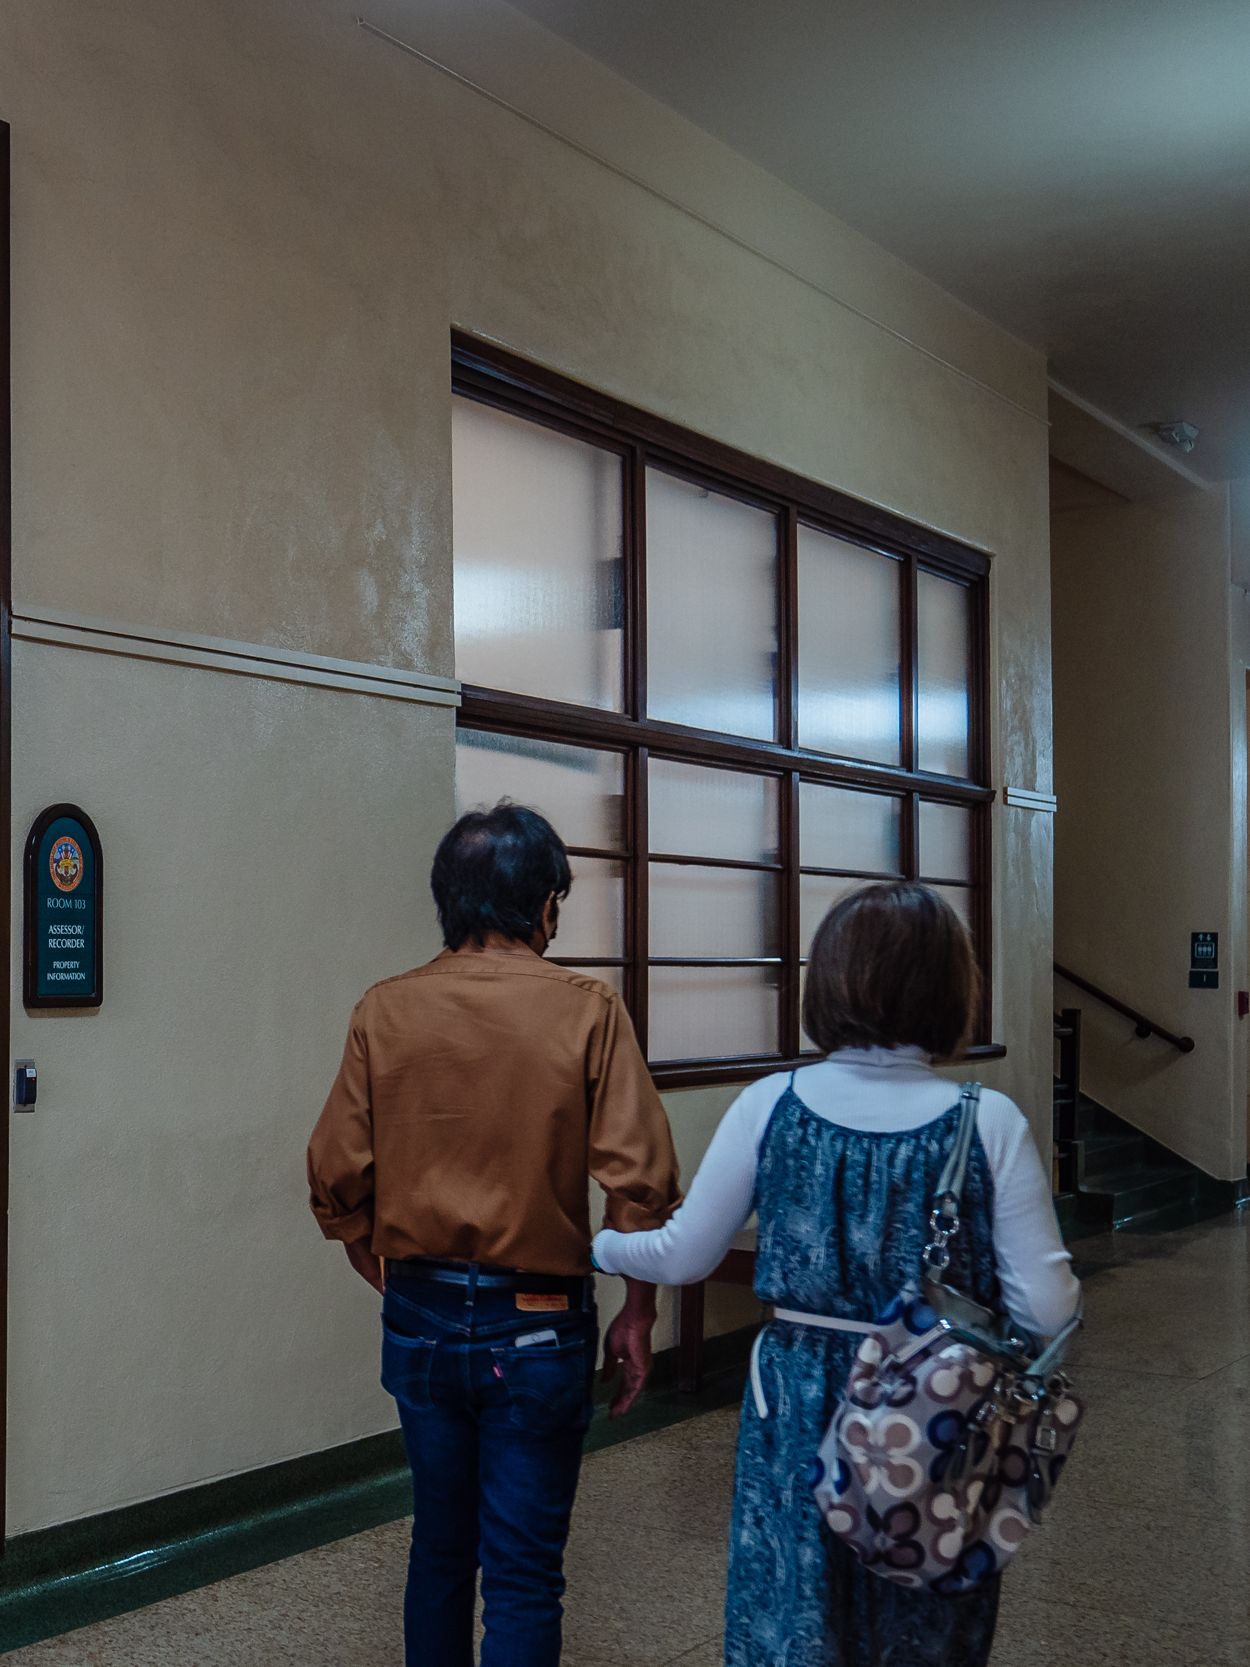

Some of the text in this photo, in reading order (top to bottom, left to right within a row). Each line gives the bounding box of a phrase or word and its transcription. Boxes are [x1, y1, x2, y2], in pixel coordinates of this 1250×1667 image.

[47, 898, 86, 909] ROOM 103
[48, 924, 85, 935] ASSESSOR/
[48, 938, 85, 949] RECORDER
[52, 961, 80, 969] PROPERTY
[46, 972, 86, 980] INFORMATION
